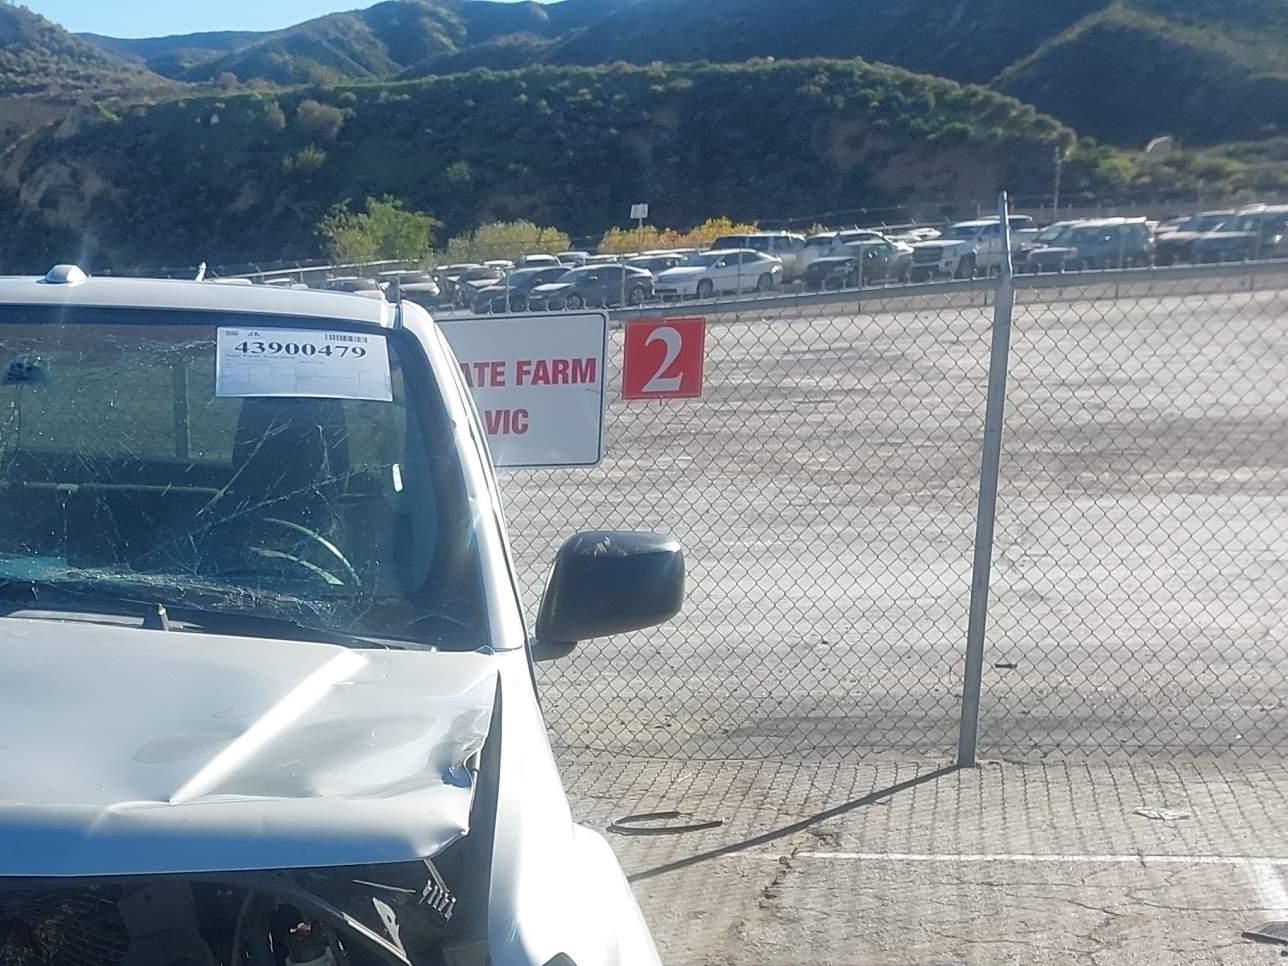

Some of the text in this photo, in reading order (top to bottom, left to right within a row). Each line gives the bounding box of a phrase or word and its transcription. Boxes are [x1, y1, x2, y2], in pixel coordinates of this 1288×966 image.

[234, 340, 367, 360] 43900479
[641, 326, 684, 393] 2
[515, 358, 597, 386] FARM
[484, 408, 529, 435] VIC
